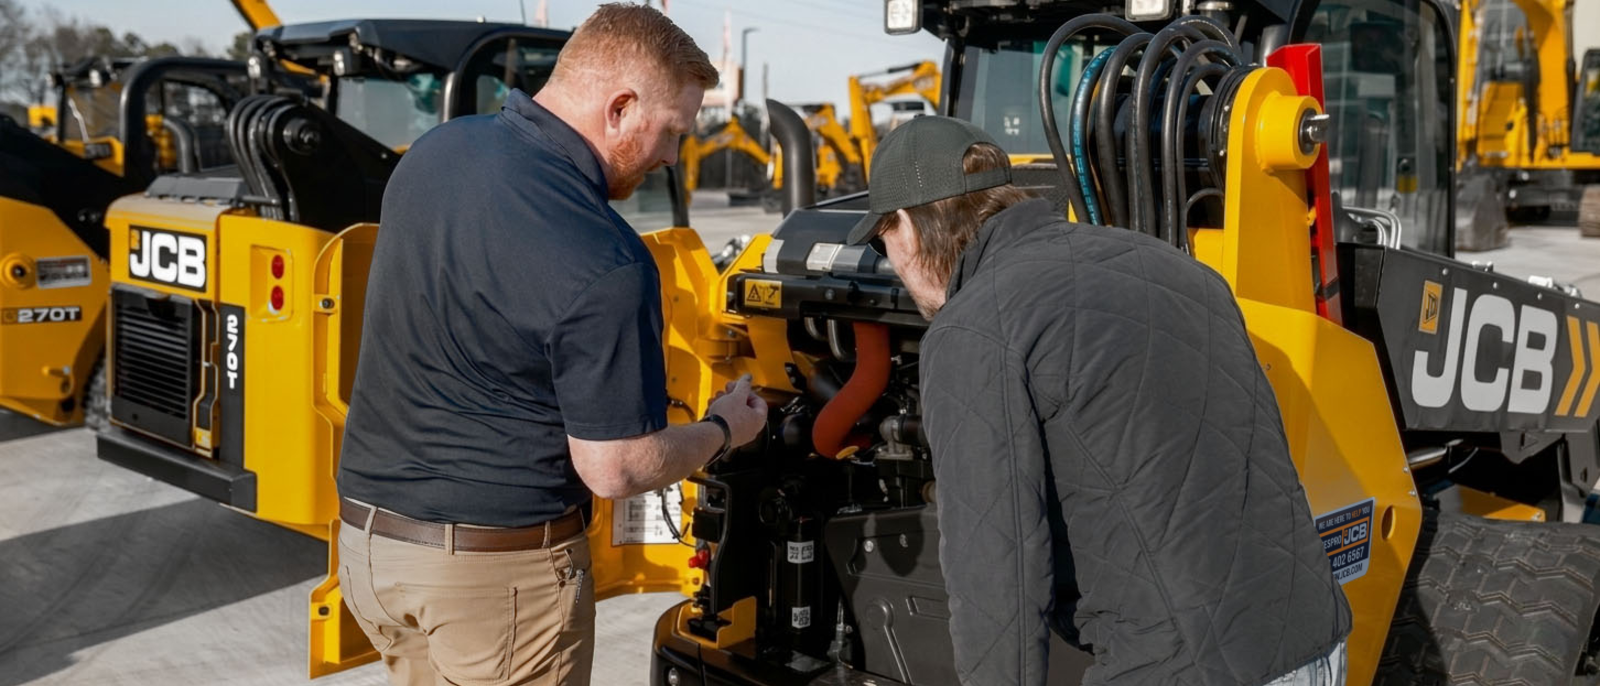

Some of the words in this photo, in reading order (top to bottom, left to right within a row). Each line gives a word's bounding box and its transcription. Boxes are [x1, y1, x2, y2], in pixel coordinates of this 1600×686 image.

[129, 230, 206, 288] JCB
[17, 306, 80, 323] 270T
[226, 314, 239, 389] 270T
[1411, 287, 1558, 415] JCB
[1326, 518, 1334, 527] ARE
[1334, 514, 1345, 525] HERE
[1352, 508, 1361, 519] HELP
[1362, 506, 1370, 514] YOU
[1323, 534, 1342, 549] ESPRO
[1344, 522, 1367, 545] JCB
[1332, 553, 1346, 569] 402
[1347, 546, 1365, 563] 6567
